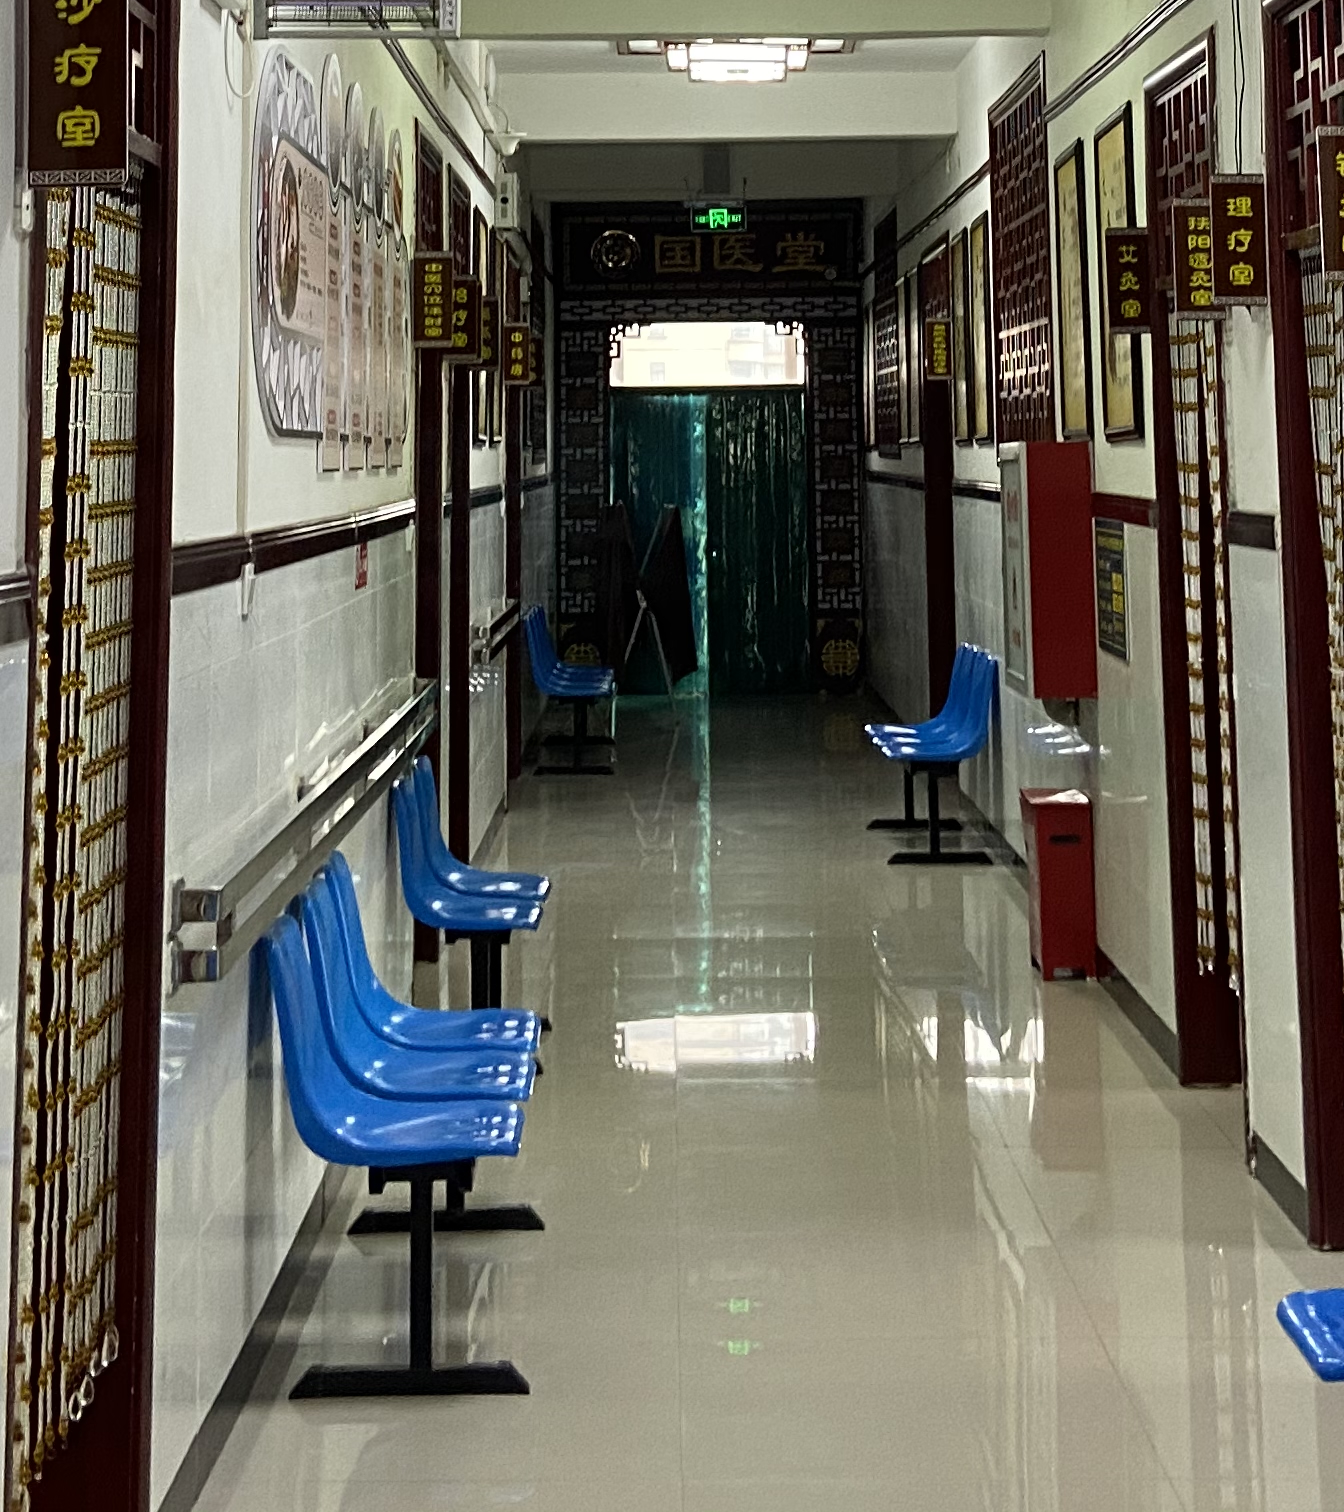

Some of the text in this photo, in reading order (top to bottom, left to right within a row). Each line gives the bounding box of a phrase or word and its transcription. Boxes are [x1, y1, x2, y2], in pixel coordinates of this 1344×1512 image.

[654, 232, 826, 274] 国医堂
[1226, 196, 1254, 286] 理疗室
[1118, 245, 1142, 318] 艾灸室
